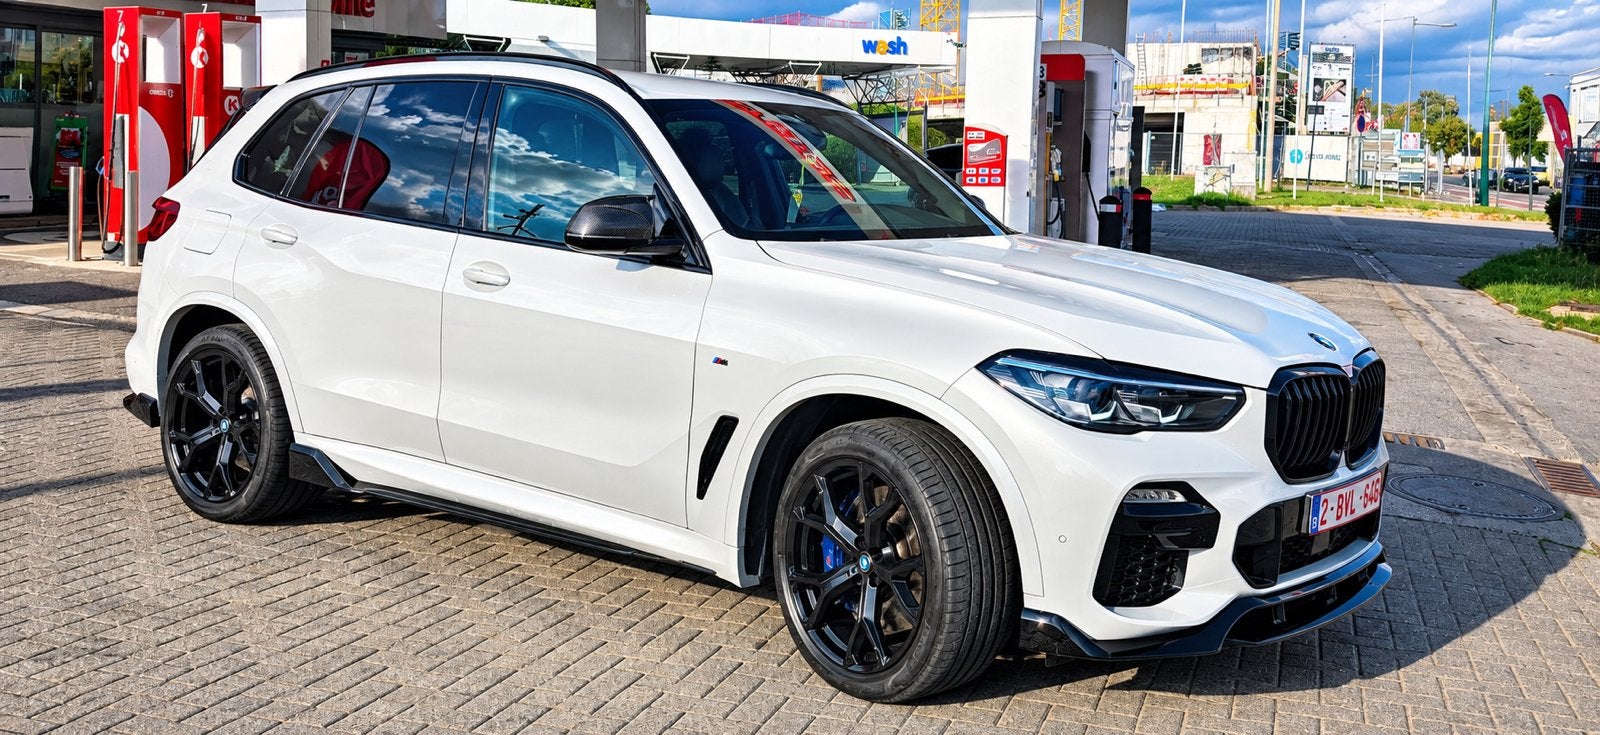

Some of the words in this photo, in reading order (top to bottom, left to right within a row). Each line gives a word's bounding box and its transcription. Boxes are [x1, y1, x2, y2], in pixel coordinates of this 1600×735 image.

[201, 3, 208, 13] 7
[117, 10, 124, 22] 7
[862, 36, 908, 55] wash
[1312, 517, 1318, 529] B
